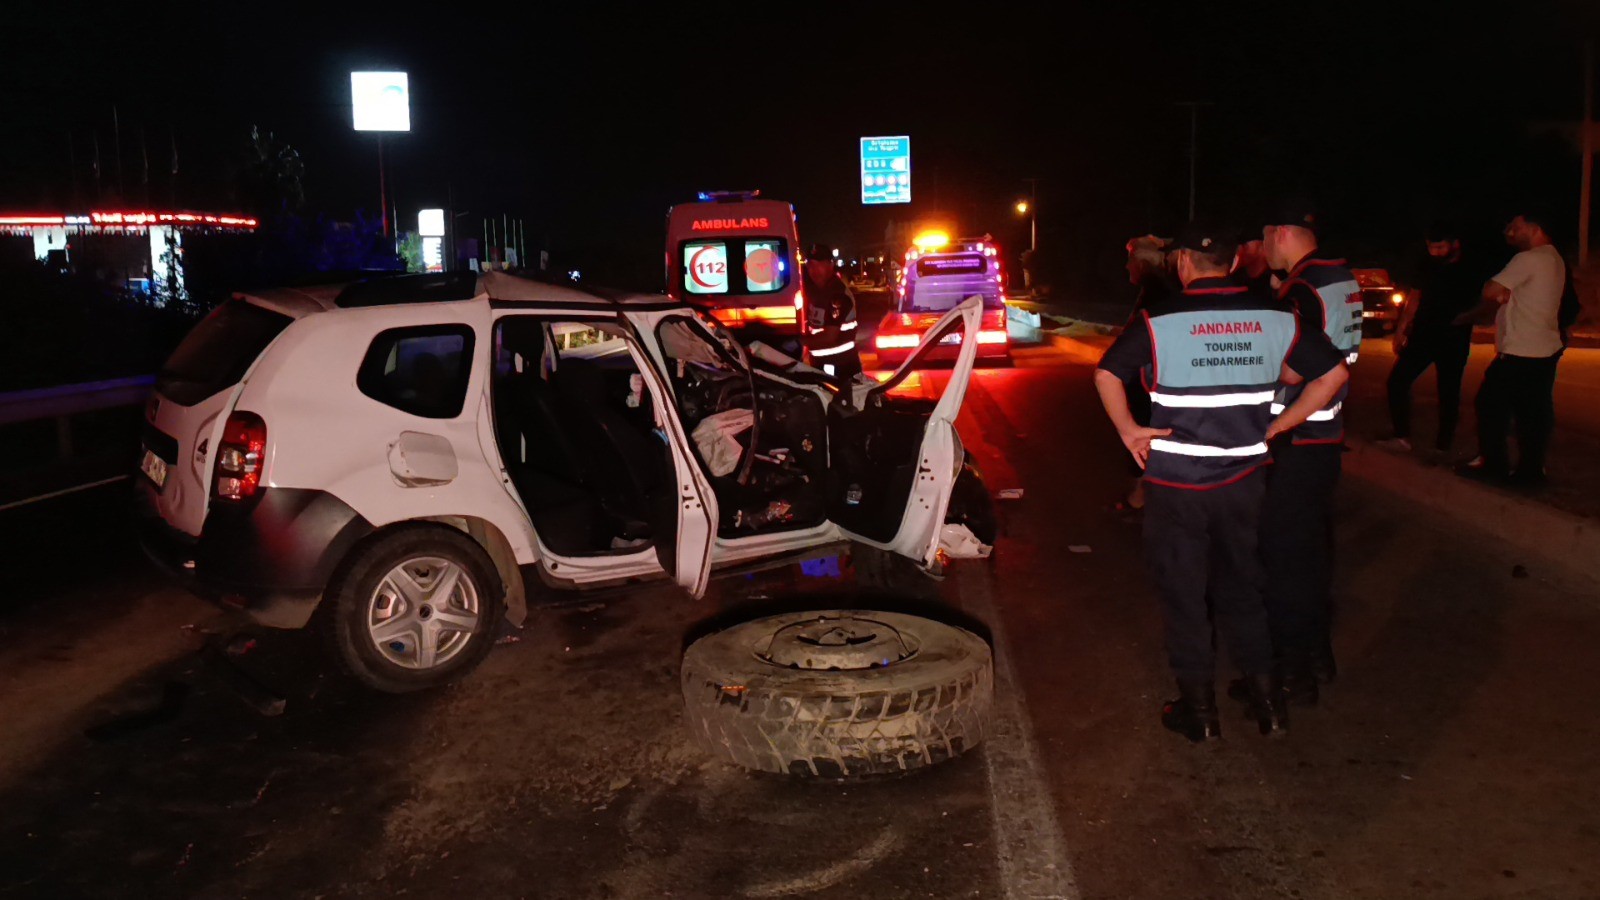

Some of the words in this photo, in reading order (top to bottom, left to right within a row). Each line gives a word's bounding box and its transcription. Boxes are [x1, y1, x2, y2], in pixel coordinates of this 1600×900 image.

[692, 218, 768, 230] AMBULANS
[696, 262, 726, 275] 112
[1189, 320, 1263, 335] JANDARMA
[1204, 341, 1252, 352] TOURISM
[1191, 356, 1264, 367] GENDARMERIE
